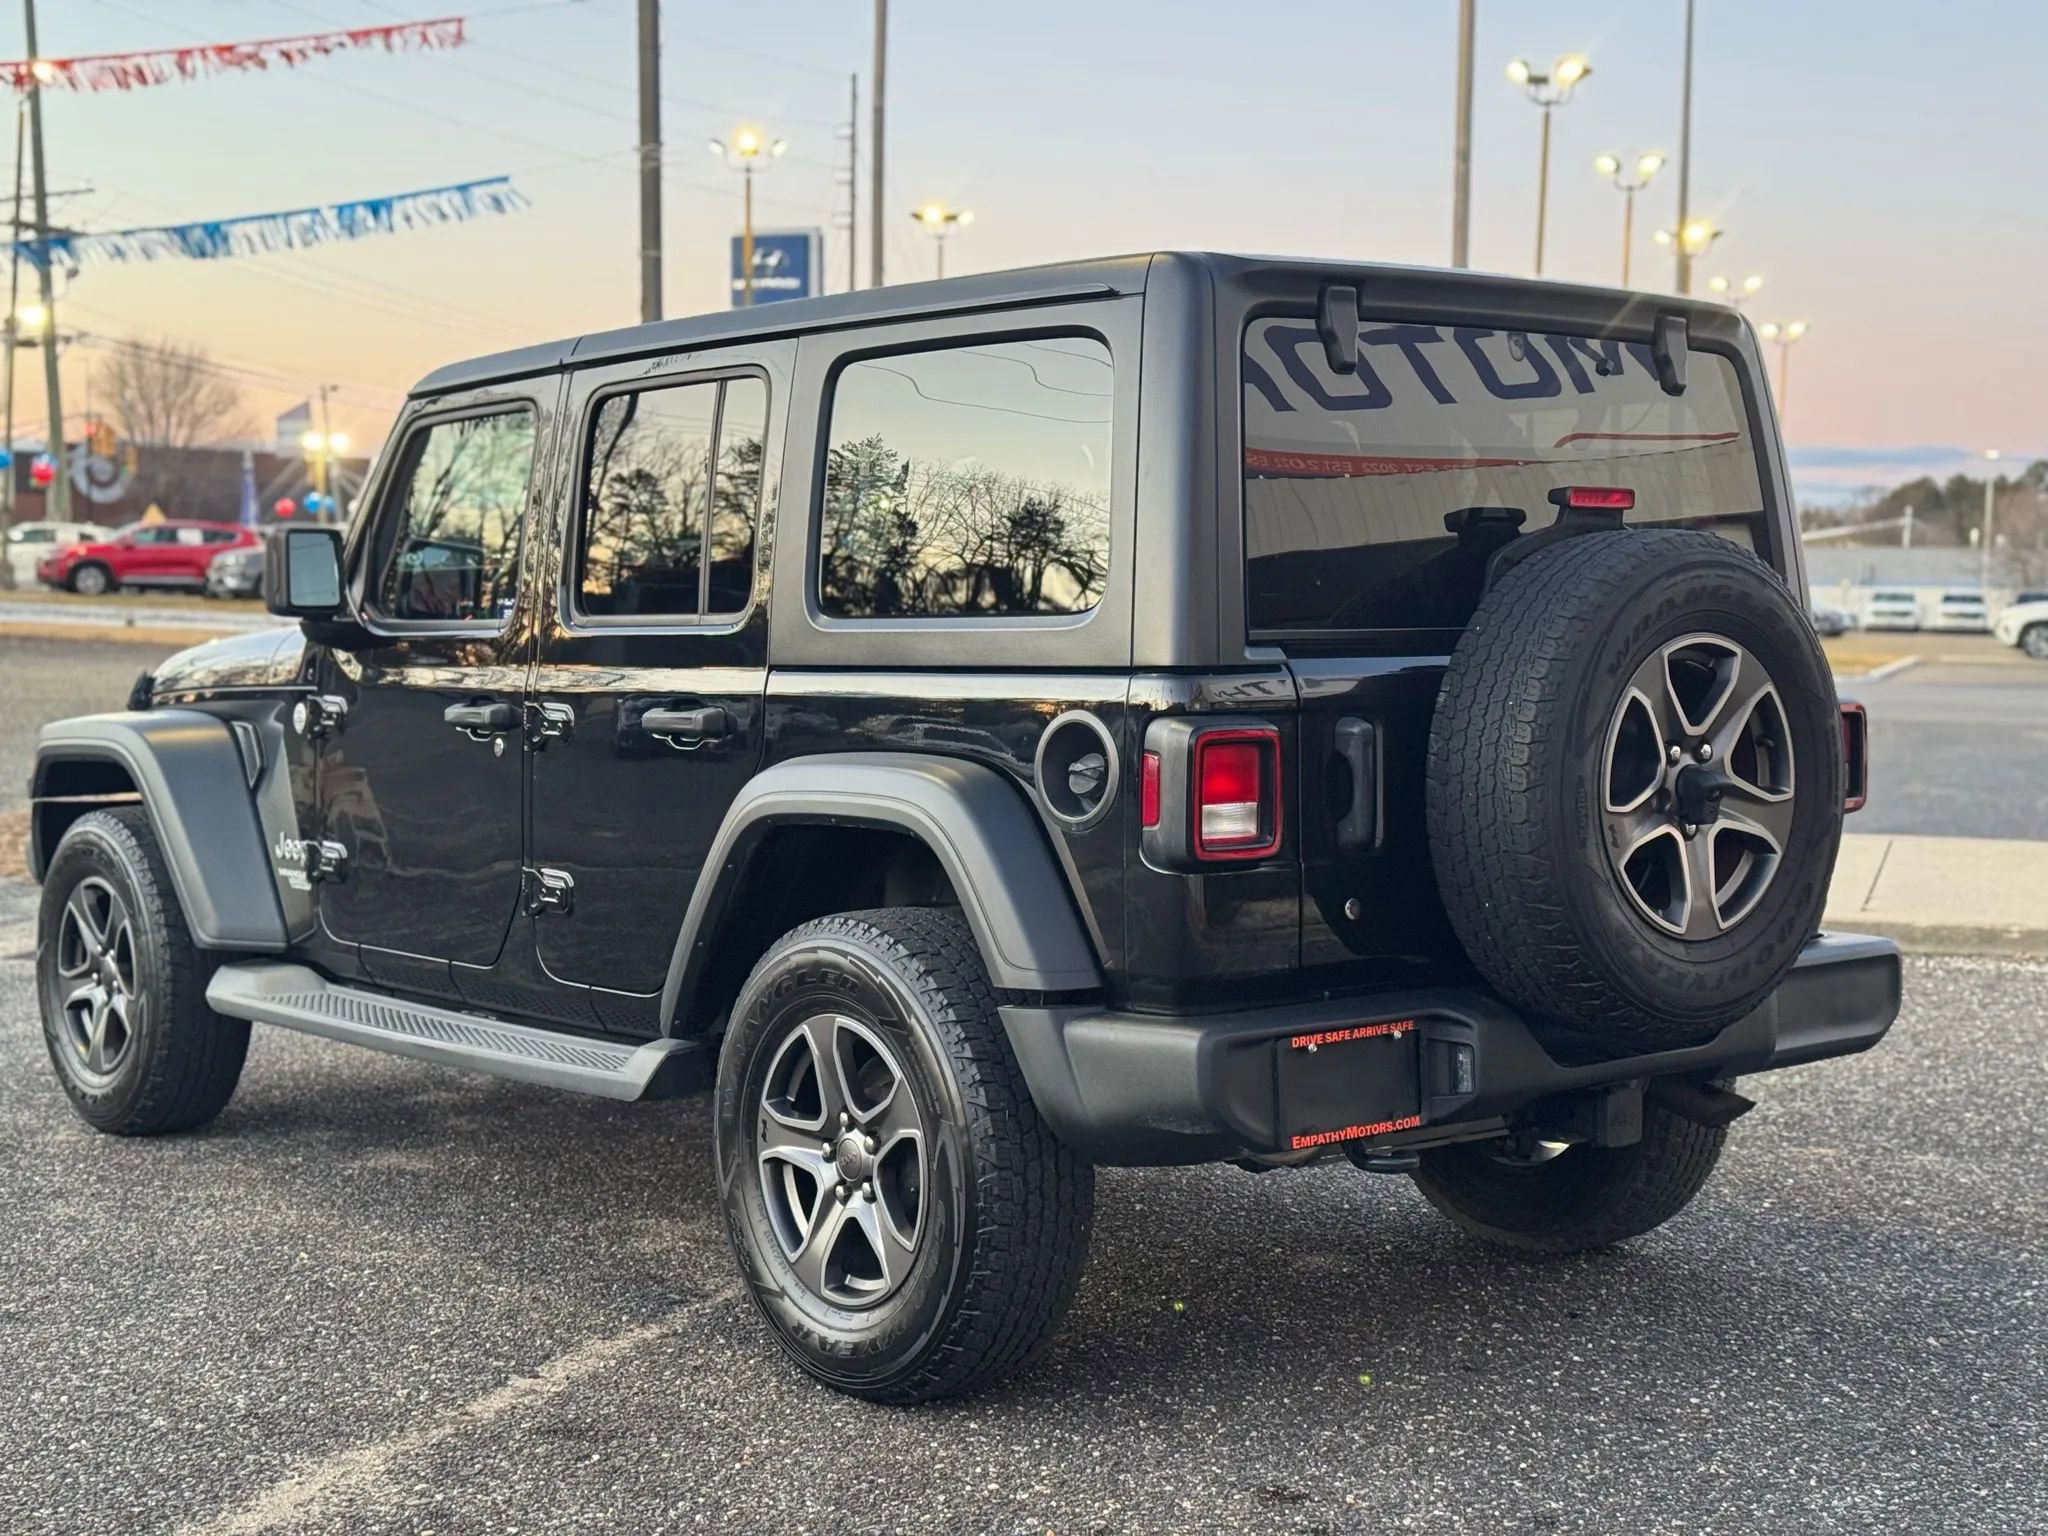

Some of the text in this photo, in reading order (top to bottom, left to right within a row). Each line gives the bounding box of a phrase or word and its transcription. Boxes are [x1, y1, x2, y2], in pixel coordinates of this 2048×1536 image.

[1292, 1019, 1415, 1049] DRIVE SAFE ARRIVE SAFE
